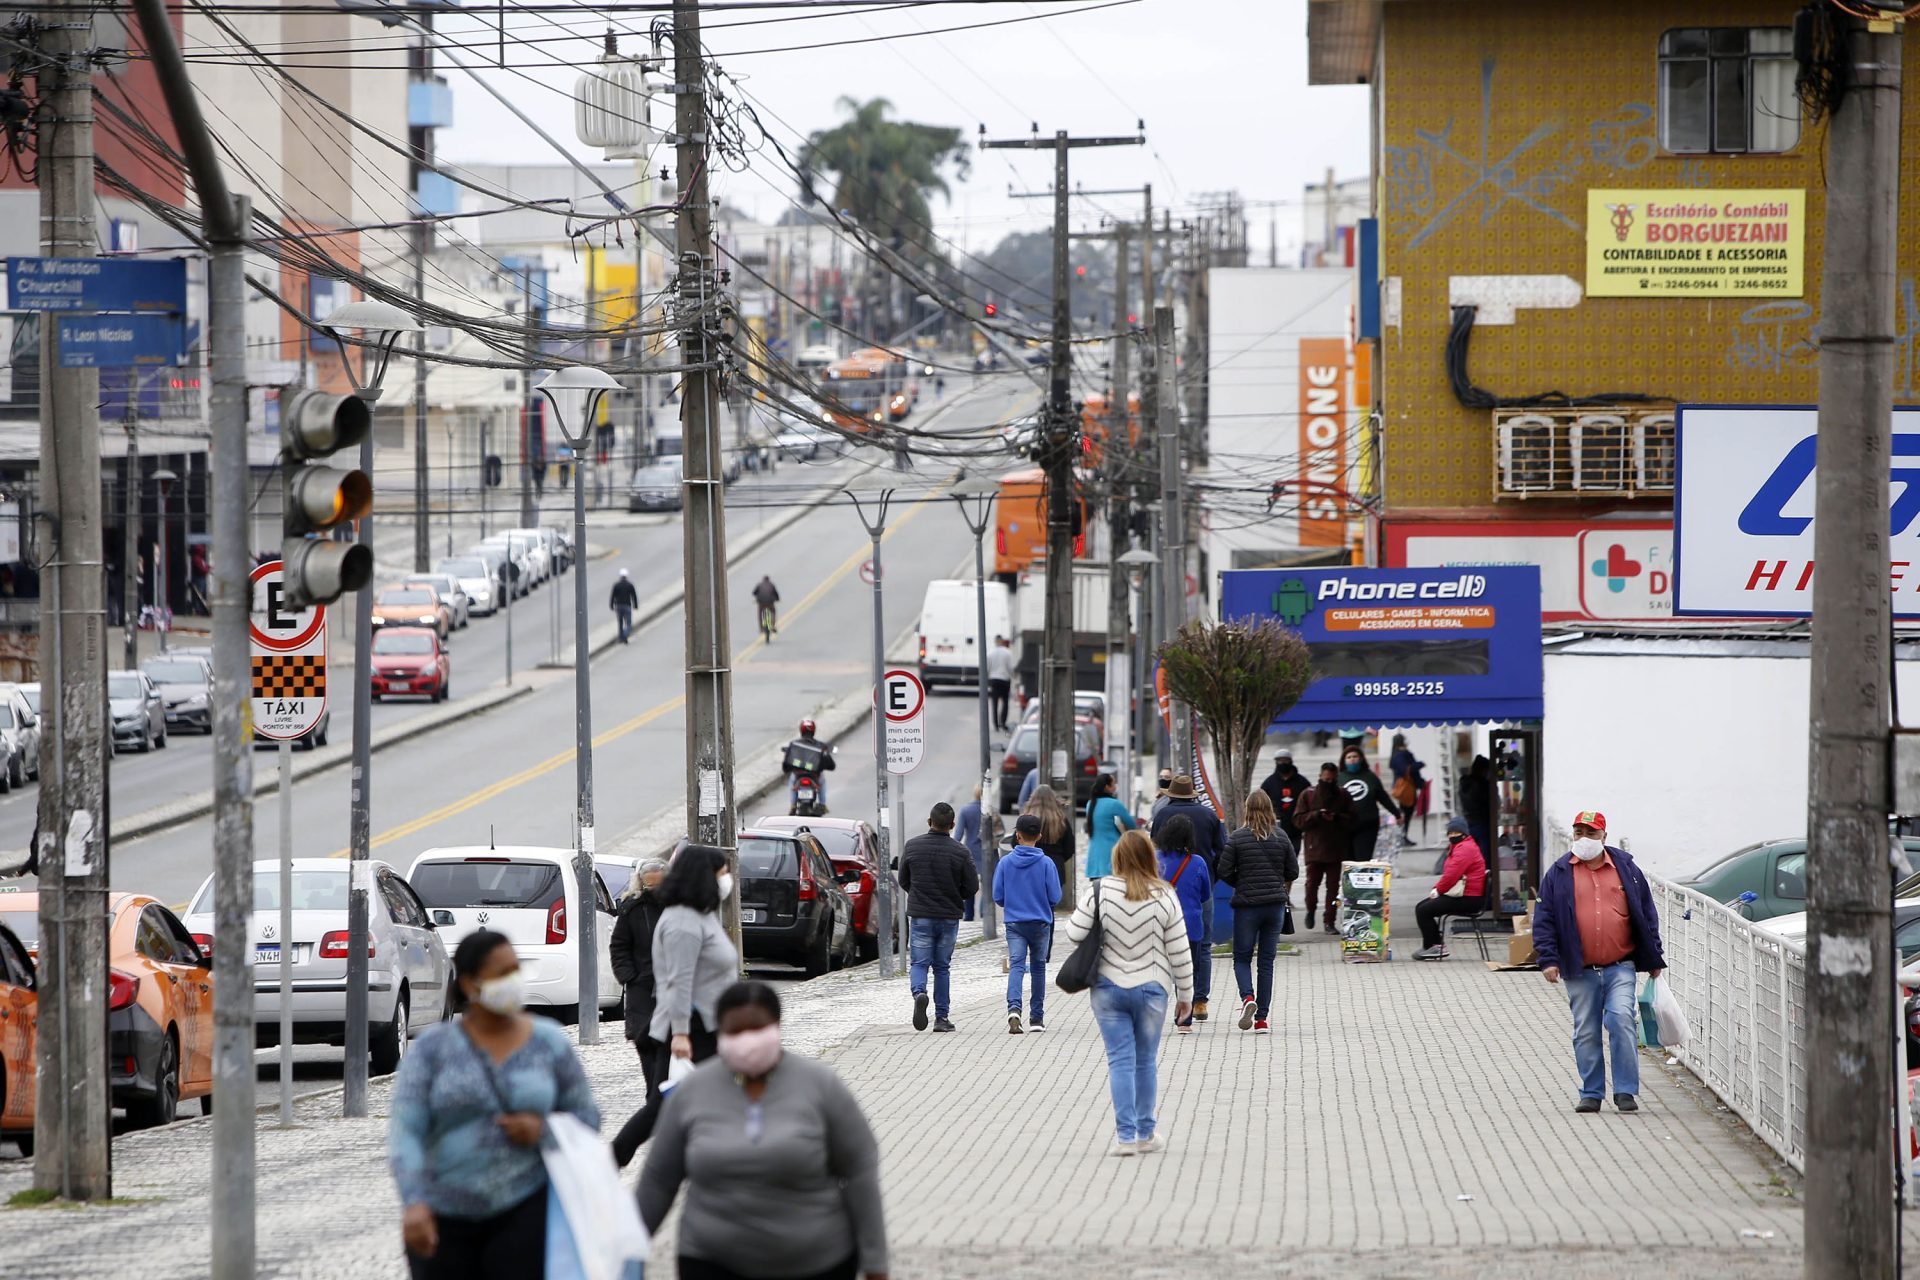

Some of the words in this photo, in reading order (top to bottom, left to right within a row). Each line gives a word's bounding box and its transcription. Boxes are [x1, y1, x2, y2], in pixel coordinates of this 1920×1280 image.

[1646, 203, 1718, 218] Escritório
[1723, 202, 1788, 218] Contábil
[1646, 223, 1788, 243] BORGUEZANI
[1603, 249, 1701, 261] CONTABILIDADE
[1706, 249, 1713, 261] E
[1717, 249, 1788, 260] ACESSORIA
[16, 260, 38, 274] Av.
[42, 260, 101, 275] Winston
[1603, 266, 1648, 275] ABERTURA
[1651, 266, 1656, 275] E
[1658, 266, 1726, 275] ENCERRAMENTO
[1729, 266, 1740, 275] DE
[1743, 266, 1788, 275] EMPRESAS
[16, 278, 83, 293] Churchill
[62, 329, 73, 342] R.
[1306, 366, 1339, 520] SIMONE
[1318, 577, 1417, 601] Phone
[1332, 609, 1385, 620] CELULARES
[1391, 608, 1424, 619] GAMES
[1429, 606, 1490, 618] INFORMÁTICA
[1358, 618, 1417, 630] ACESSÓRIOS
[1417, 620, 1431, 629] EM
[1432, 619, 1464, 629] GERAL
[889, 682, 907, 710] E
[1354, 682, 1444, 696] 99958-2525
[263, 699, 304, 715] TÁXI
